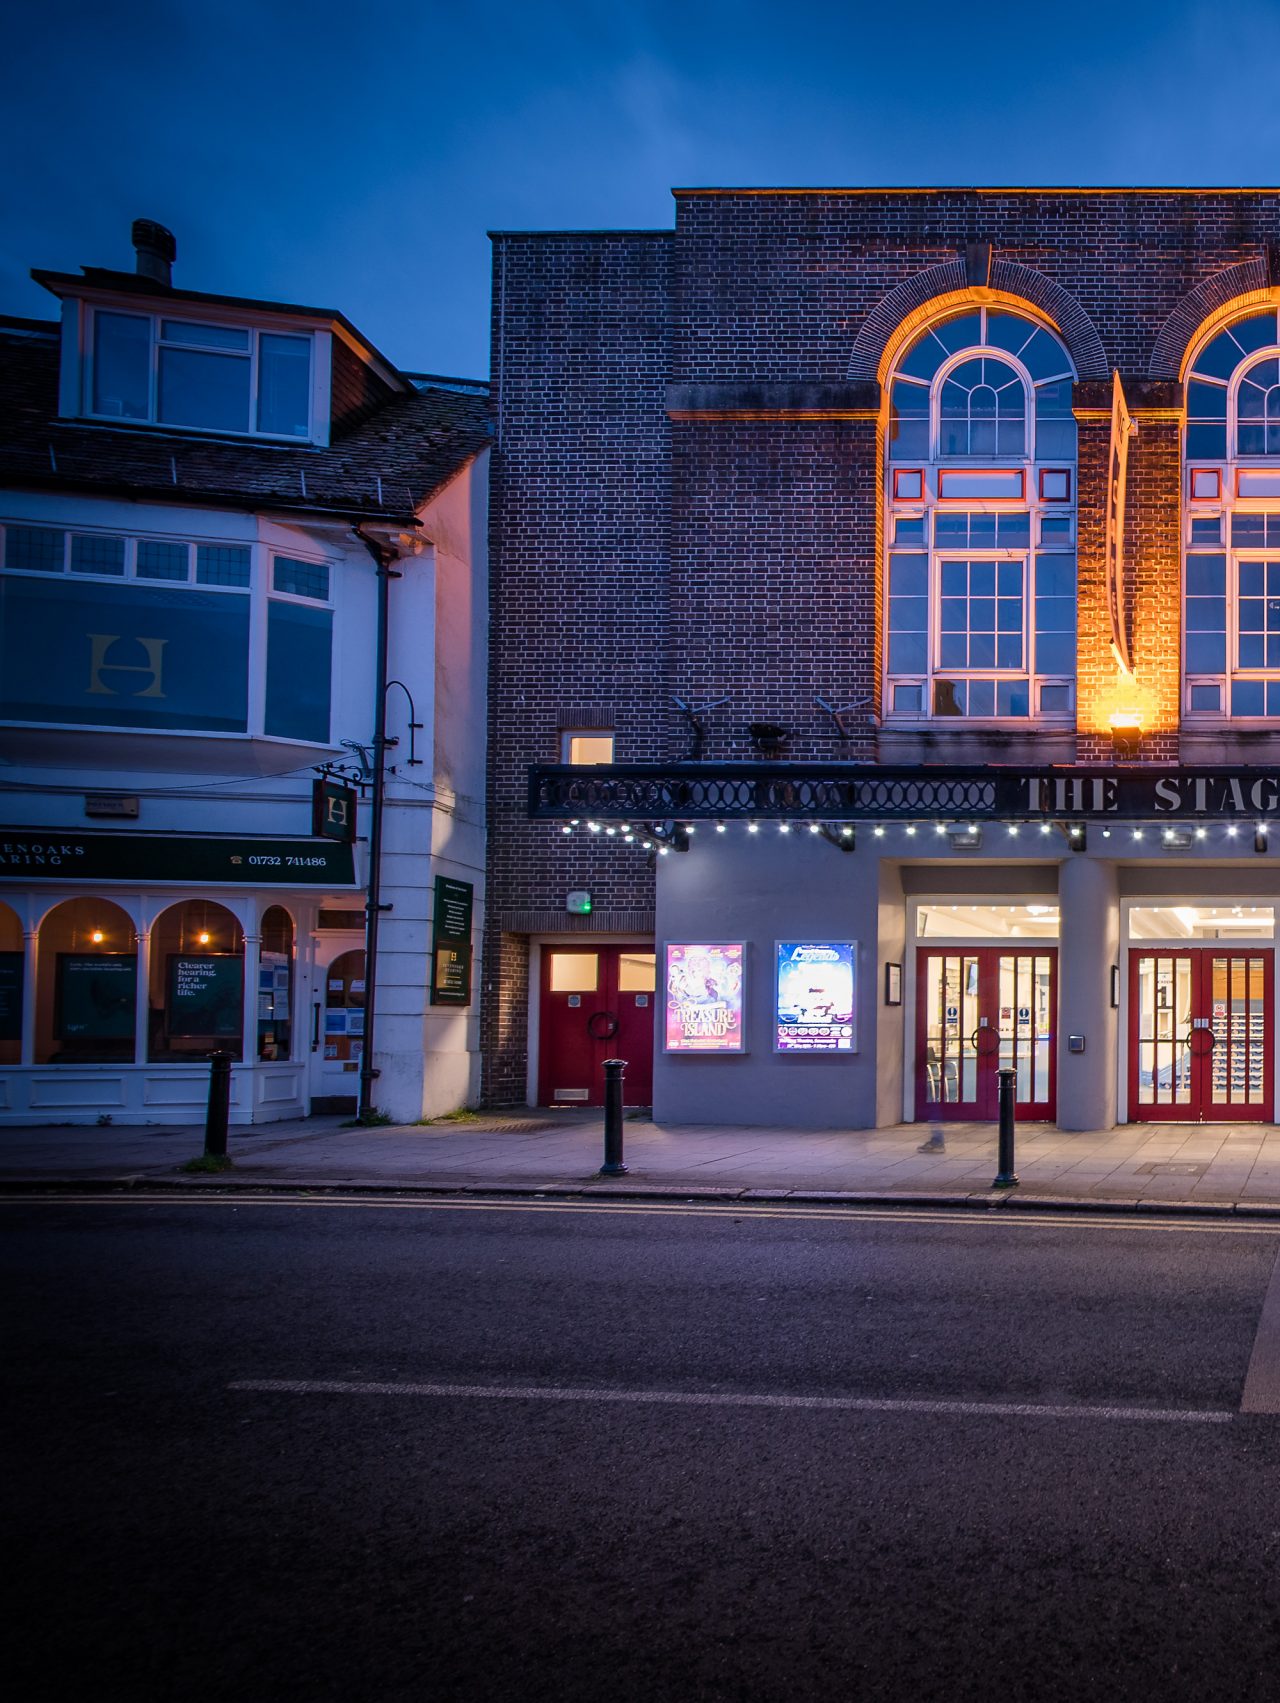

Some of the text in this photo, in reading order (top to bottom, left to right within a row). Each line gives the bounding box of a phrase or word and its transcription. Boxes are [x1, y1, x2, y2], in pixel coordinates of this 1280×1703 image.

[83, 633, 170, 698] H
[1020, 778, 1118, 811] THE
[1154, 778, 1279, 811] STAG
[327, 796, 348, 826] H
[248, 856, 326, 866] 01732 741486
[674, 1008, 736, 1029] TREASURE
[681, 1022, 726, 1036] ISLAND
